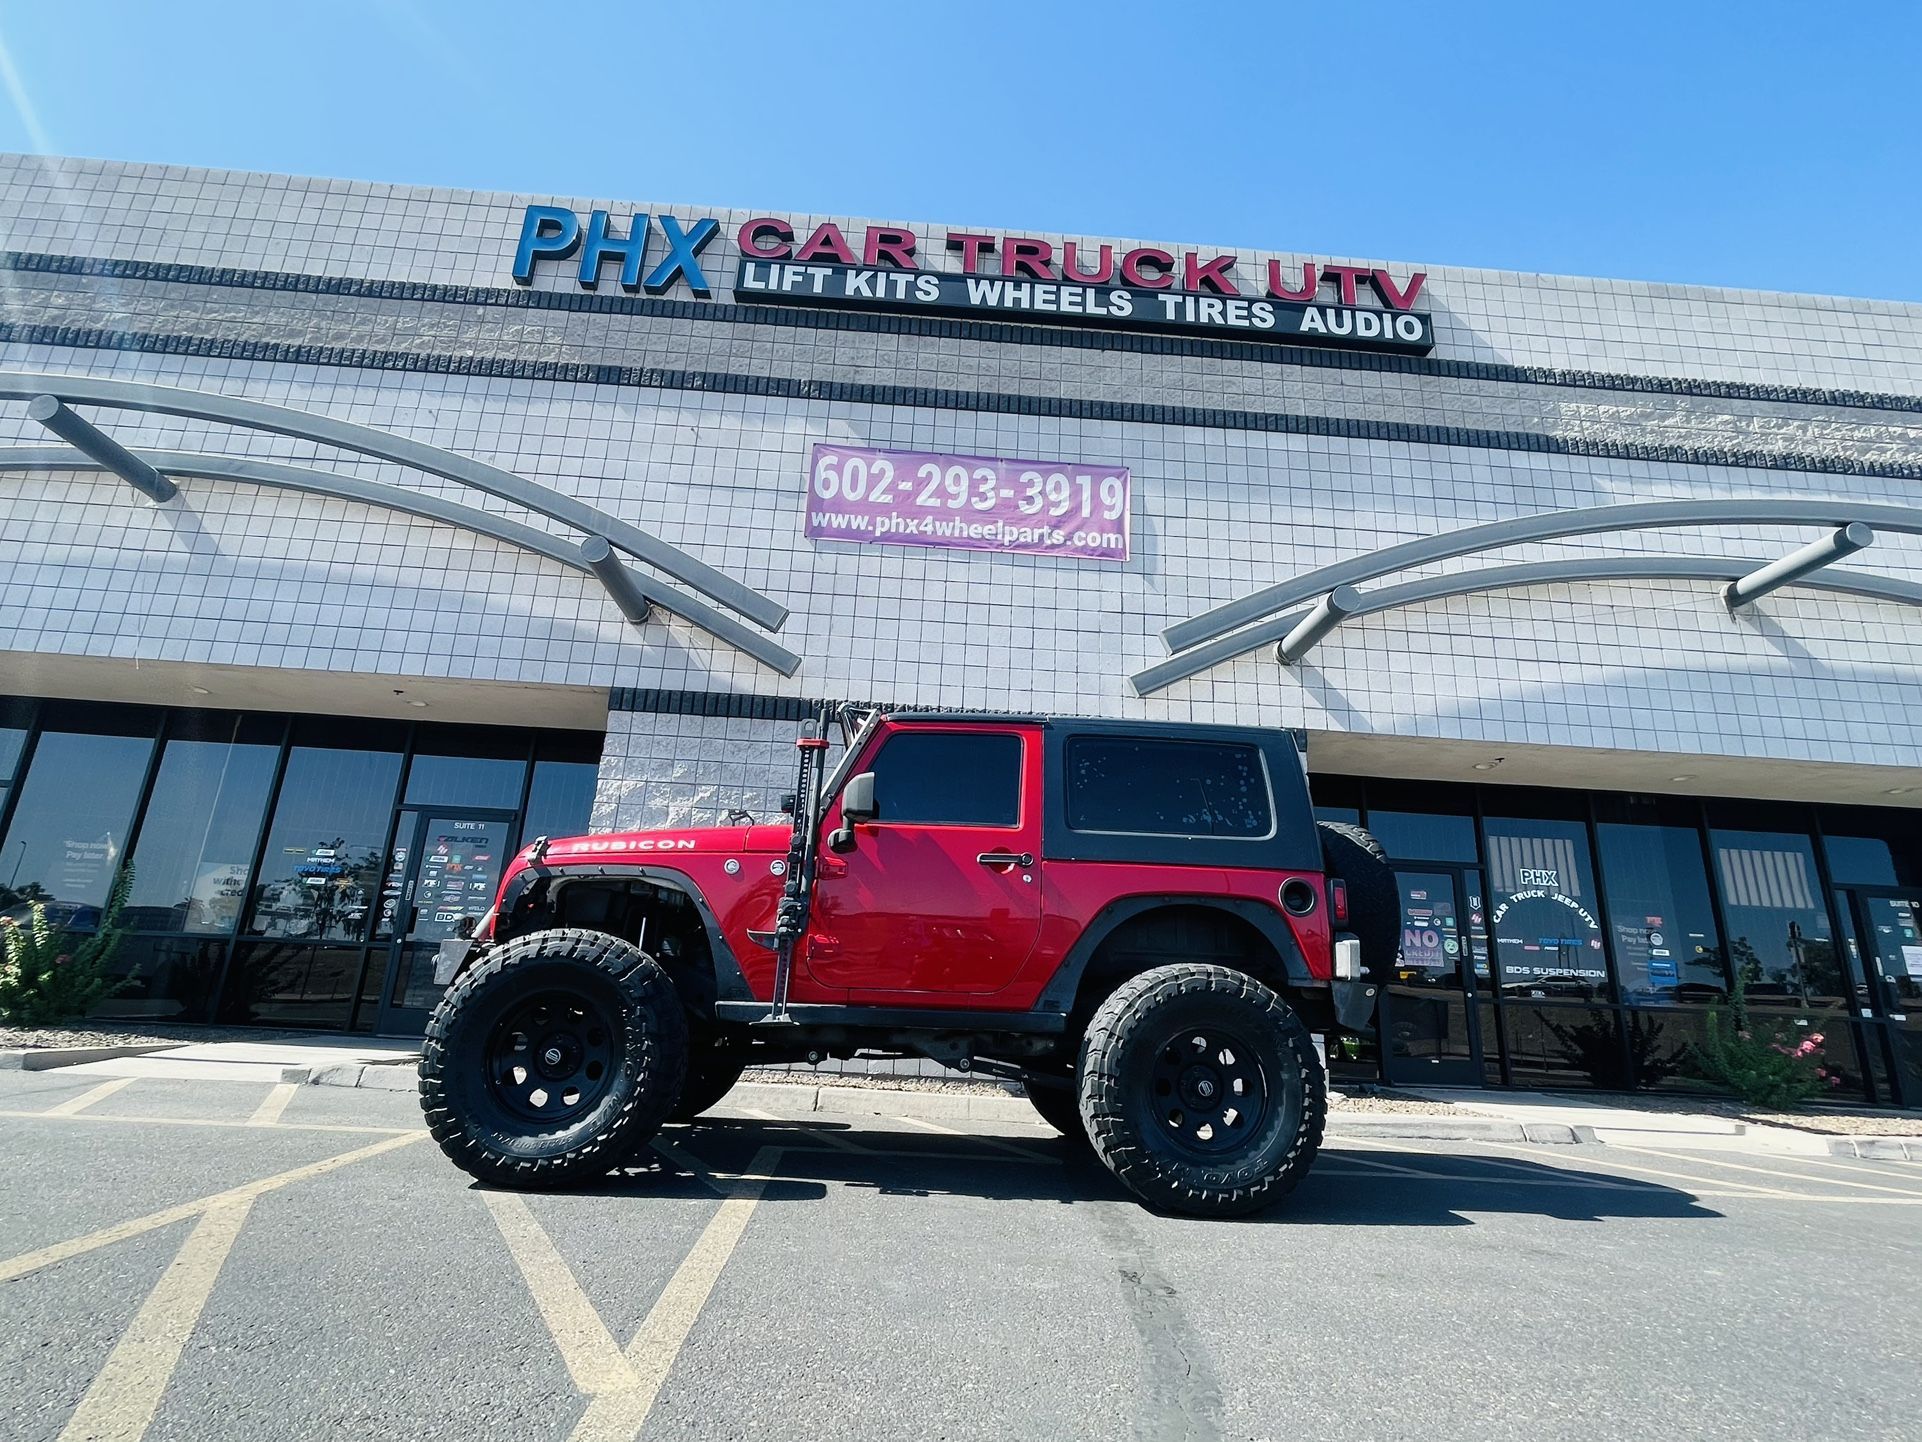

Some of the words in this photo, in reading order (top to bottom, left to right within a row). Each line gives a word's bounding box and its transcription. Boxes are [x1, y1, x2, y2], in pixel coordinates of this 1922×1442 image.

[512, 204, 721, 299] PHX
[738, 218, 920, 269] CAR
[946, 232, 1241, 297] TRUCK
[1265, 259, 1427, 311] UTV
[743, 262, 832, 294] LIFT
[845, 269, 940, 302] KITS
[966, 277, 1133, 318] WHEELS
[1158, 294, 1276, 329] TIRES
[1300, 306, 1424, 342] AUDIO
[814, 454, 1125, 520] 602-293-3919
[811, 510, 1124, 549] www.phx4wheelparts.com
[454, 822, 475, 830] SUITE
[572, 839, 696, 853] RUBICON
[1520, 868, 1559, 887] PHX
[1493, 902, 1510, 923] CAR
[1509, 890, 1546, 903] TRUCK
[1551, 893, 1579, 909] JEEP
[1578, 908, 1599, 929] UTV
[1404, 929, 1439, 948] NO
[1505, 965, 1531, 975] BDS
[1532, 966, 1606, 978] SUSPENSION
